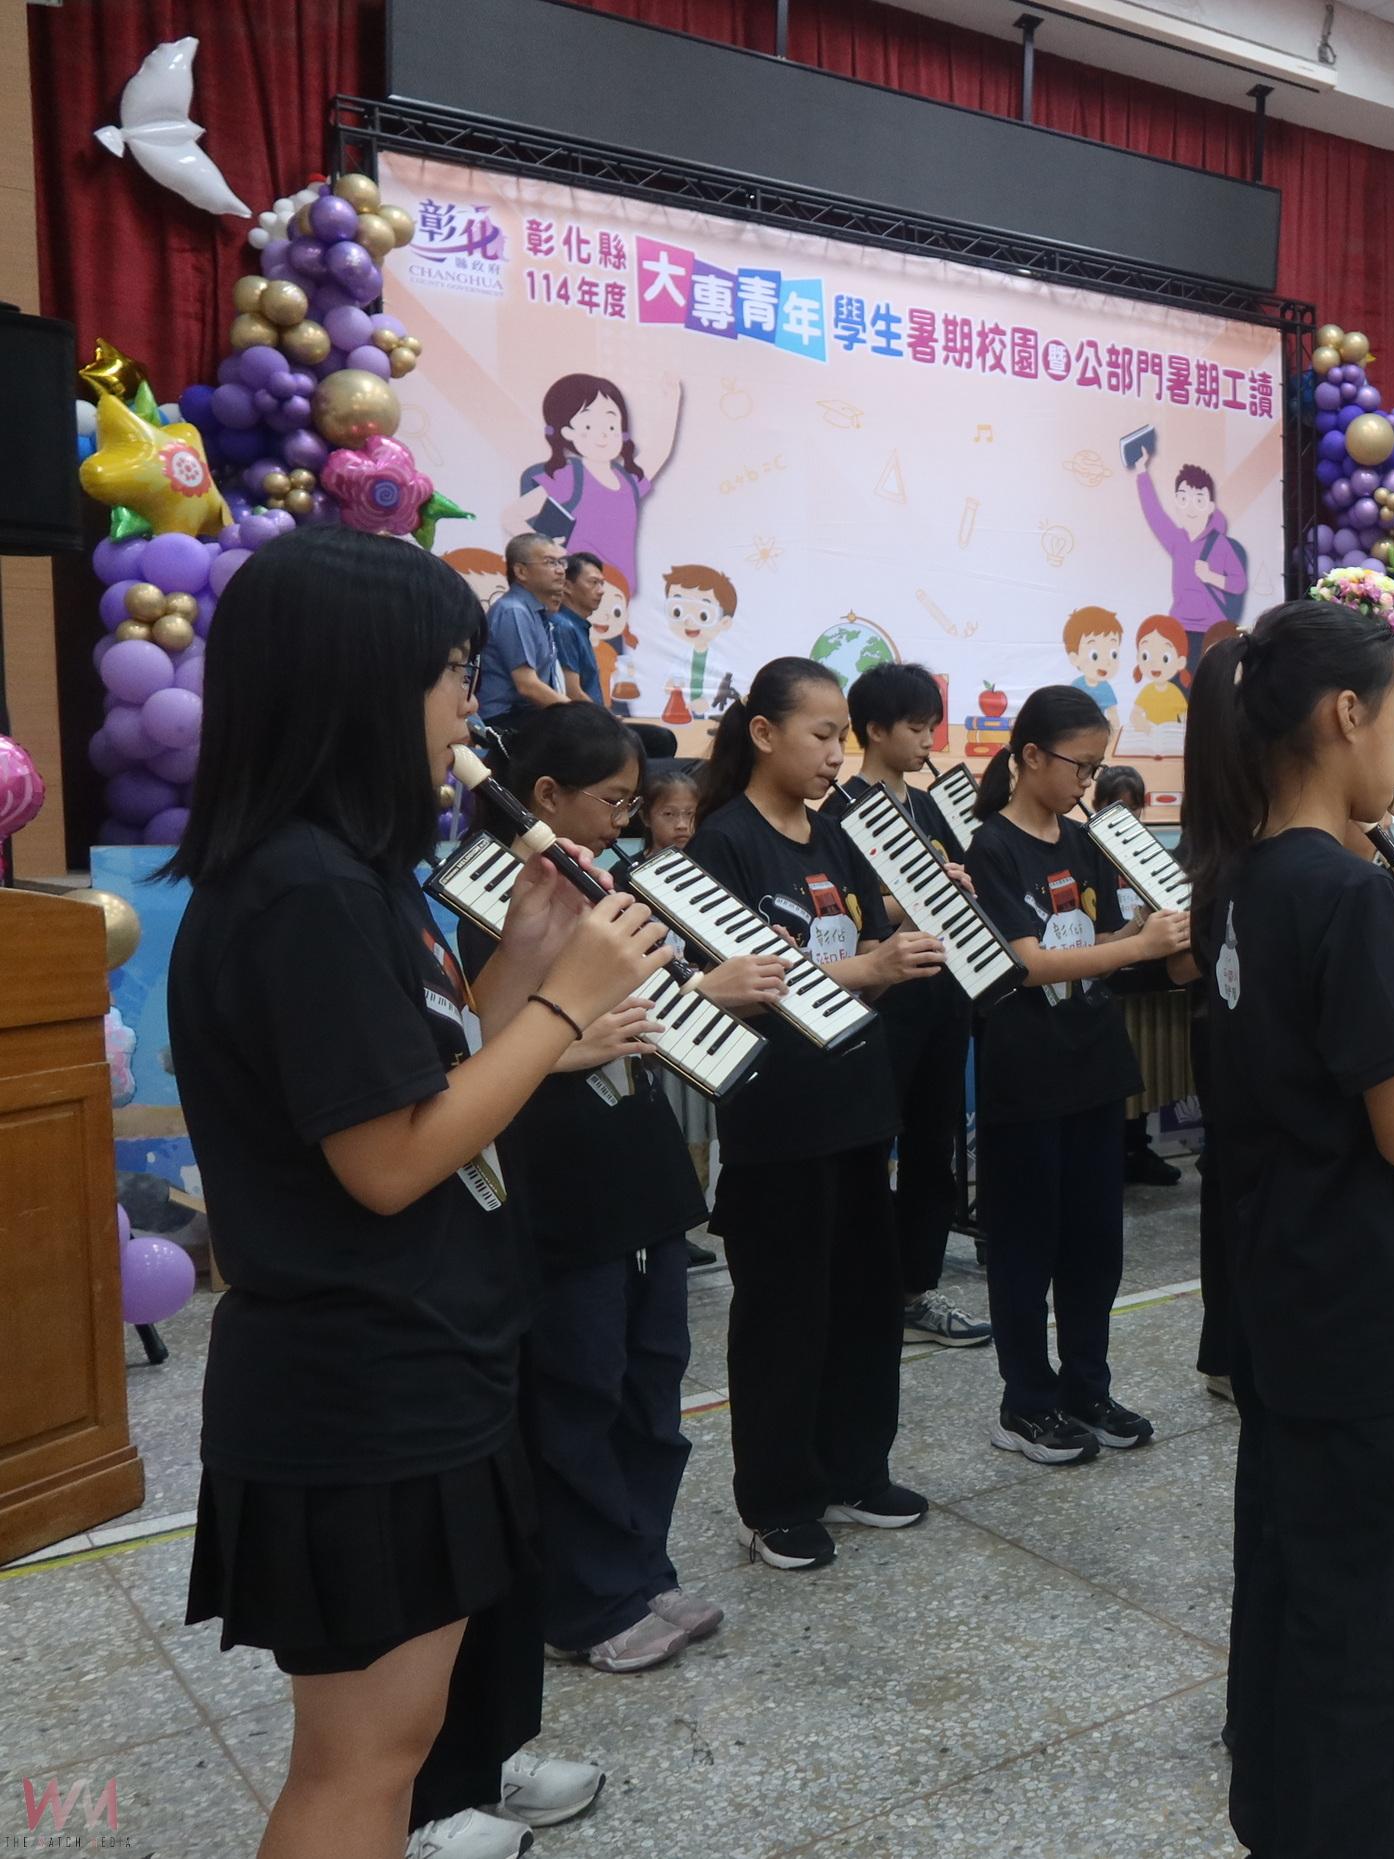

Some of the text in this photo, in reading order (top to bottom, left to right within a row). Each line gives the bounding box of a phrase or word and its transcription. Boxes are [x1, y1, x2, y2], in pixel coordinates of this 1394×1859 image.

[418, 199, 500, 260] 彰化
[525, 218, 628, 271] 彰化縣
[409, 264, 504, 290] CHANGHUA
[525, 270, 628, 320] 114年度
